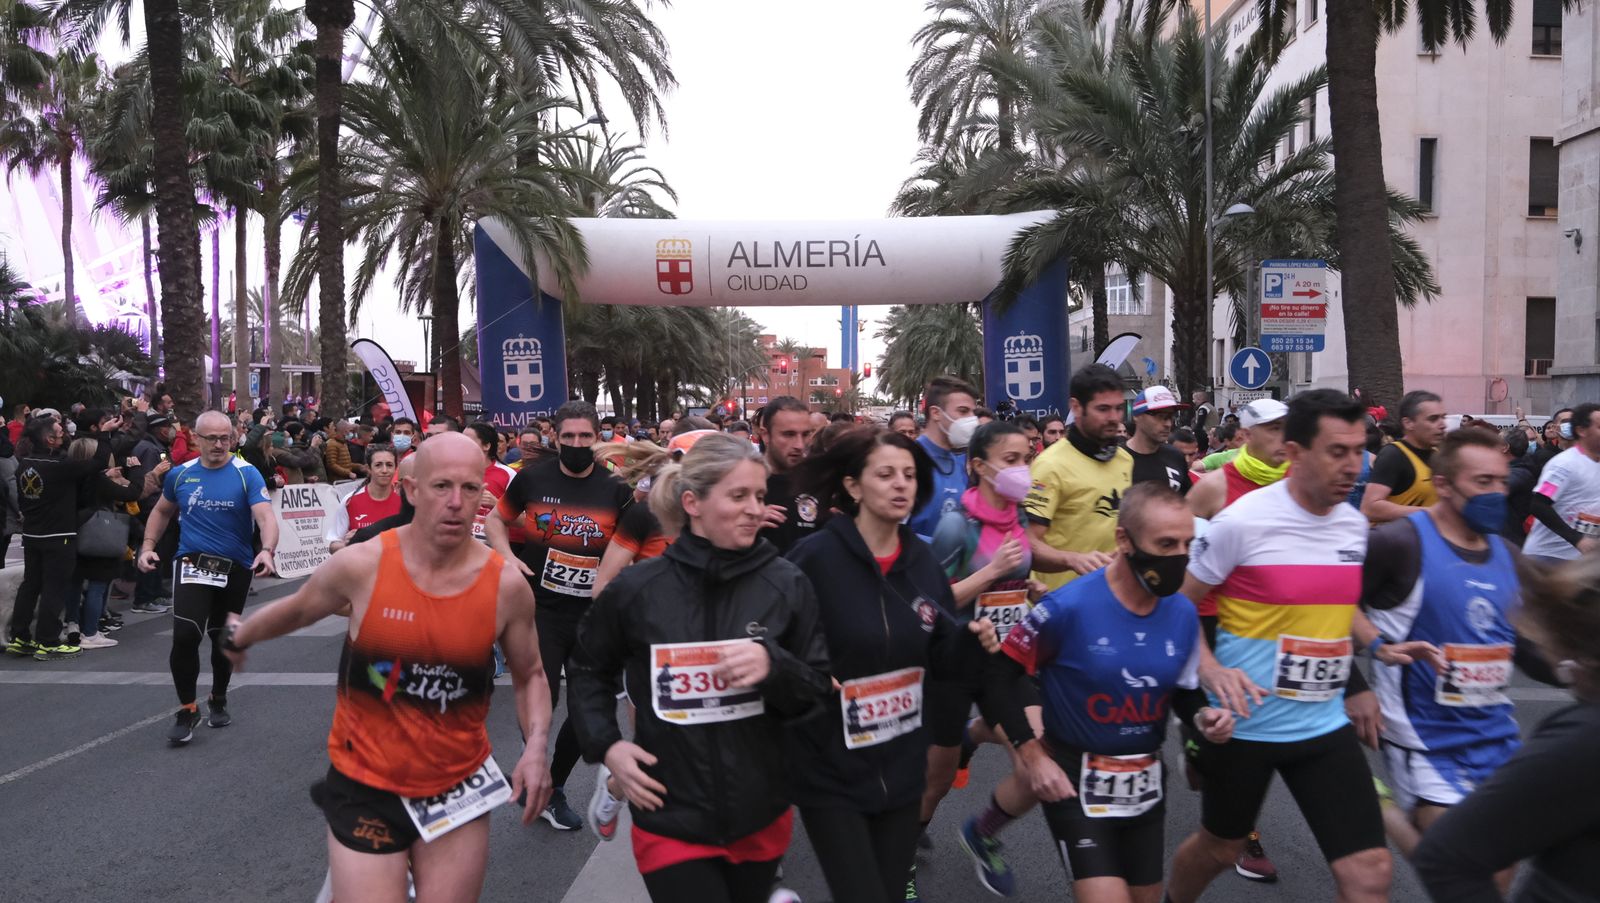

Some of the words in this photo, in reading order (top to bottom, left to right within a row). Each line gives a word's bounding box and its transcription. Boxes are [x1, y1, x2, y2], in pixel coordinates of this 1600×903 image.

[727, 234, 887, 268] ALMERÍA
[727, 274, 808, 291] CIUDAD
[1266, 274, 1281, 292] P
[281, 488, 322, 509] AMSA
[278, 549, 309, 560] Transportes
[281, 560, 308, 572] ANTONIO
[554, 566, 590, 583] 275
[990, 607, 1021, 625] 480
[1298, 659, 1342, 680] 182
[859, 692, 912, 721] 3226
[1104, 770, 1149, 796] 113
